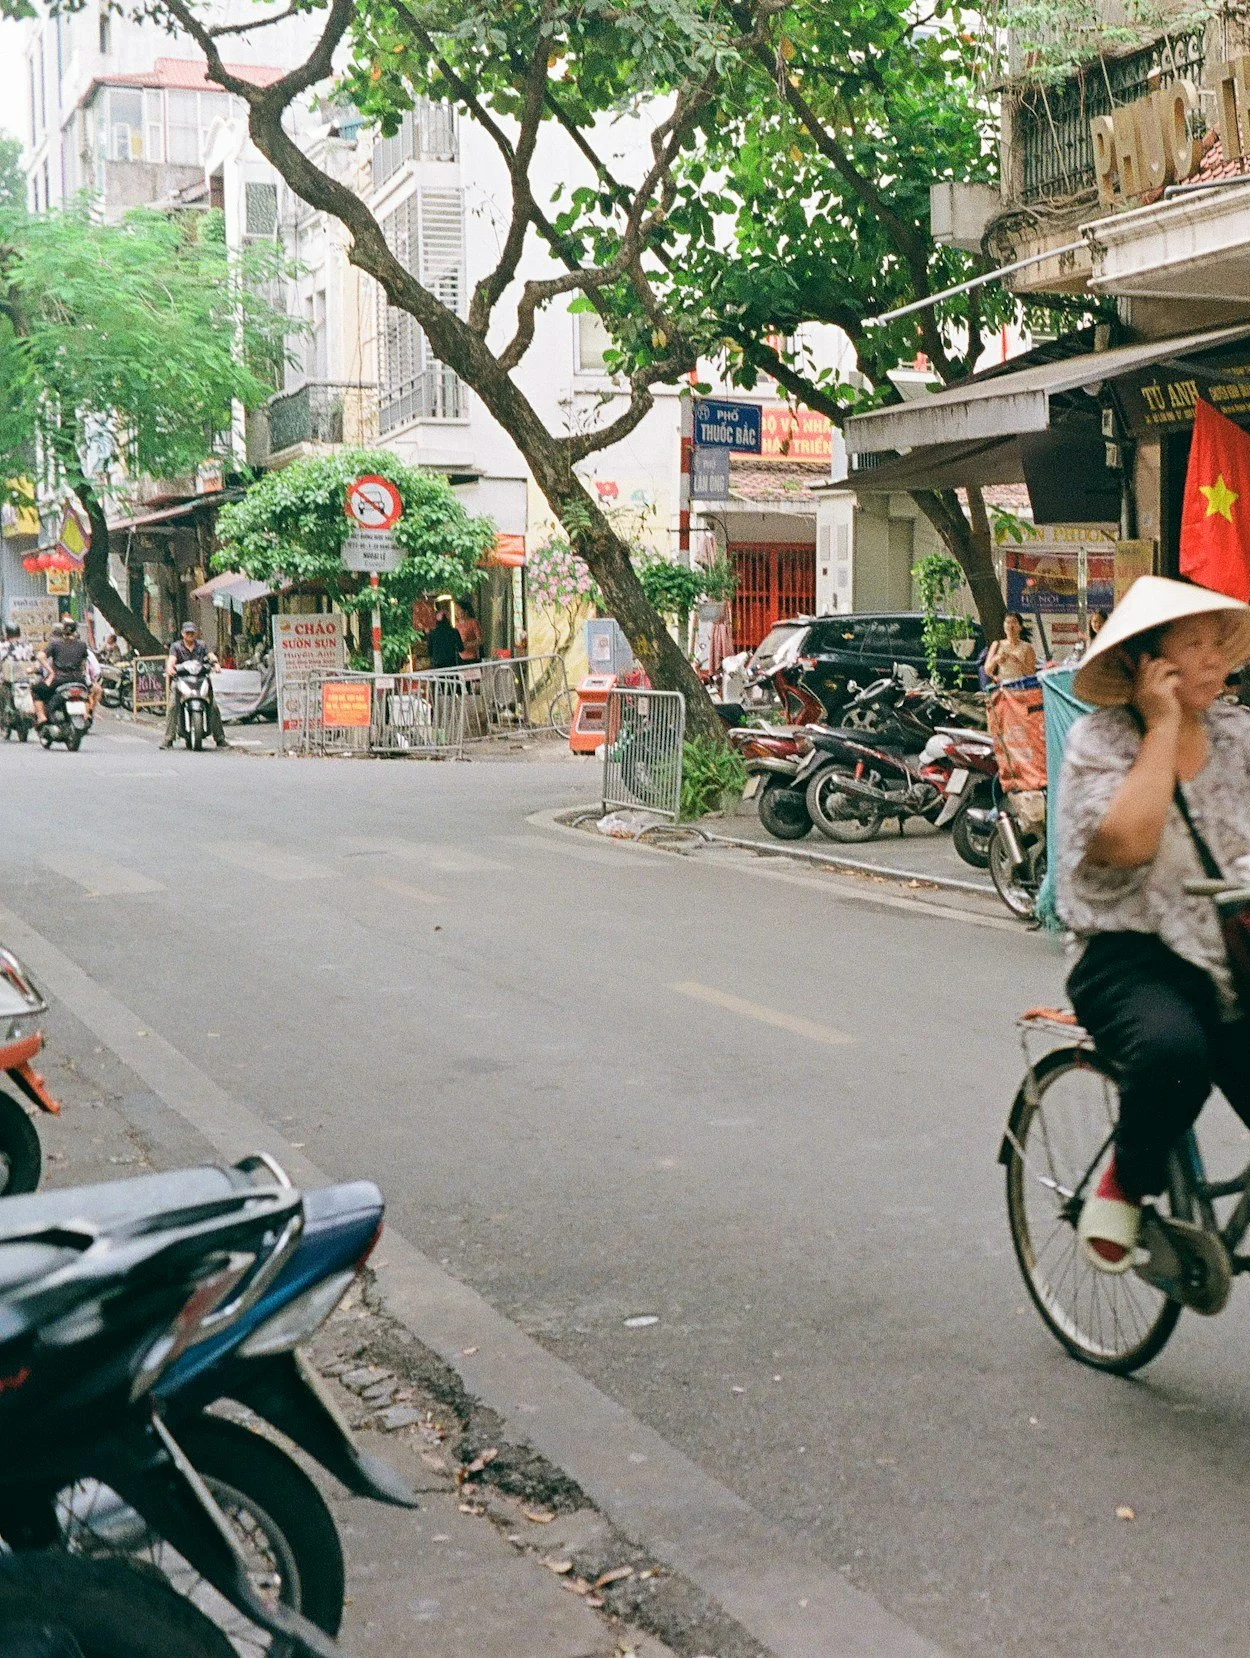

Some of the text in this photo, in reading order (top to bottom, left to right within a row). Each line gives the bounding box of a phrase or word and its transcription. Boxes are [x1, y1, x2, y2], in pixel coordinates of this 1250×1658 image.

[716, 409, 740, 422] PHỐ
[701, 421, 757, 447] THUỐC BẮC
